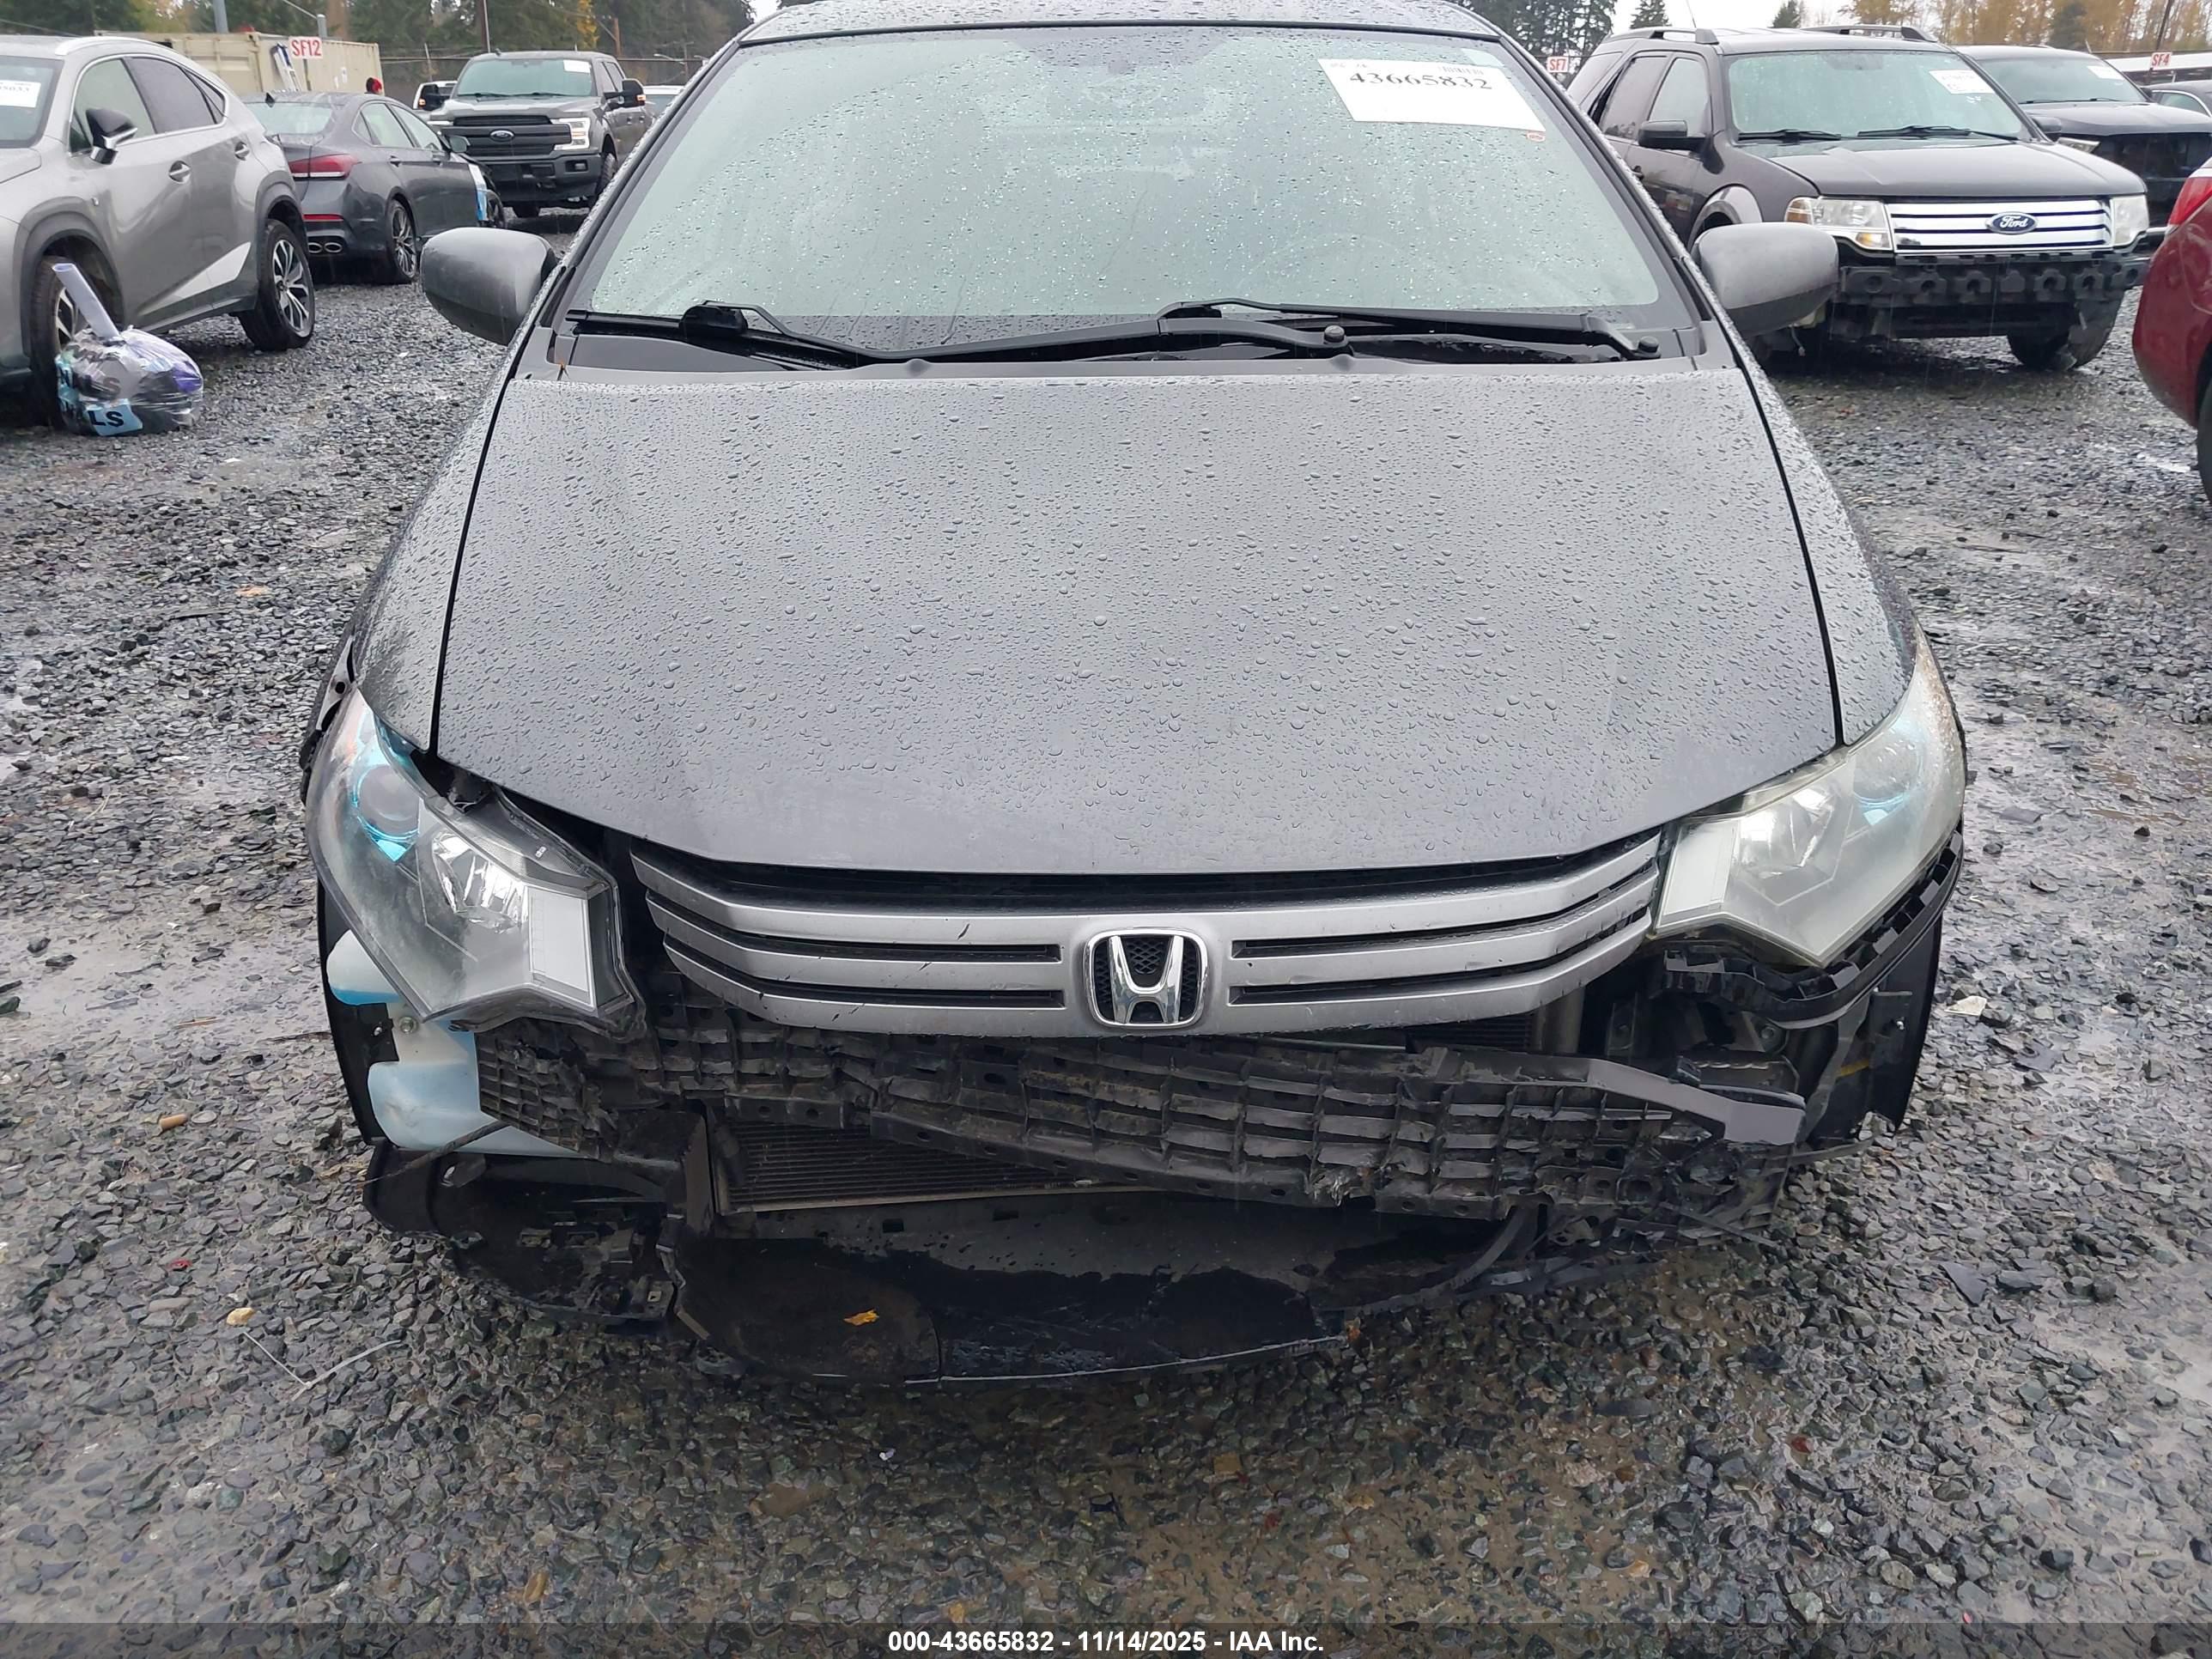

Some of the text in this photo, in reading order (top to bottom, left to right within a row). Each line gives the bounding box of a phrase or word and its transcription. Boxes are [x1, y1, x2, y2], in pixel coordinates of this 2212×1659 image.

[291, 39, 322, 57] SF12
[1549, 58, 1567, 71] SF7
[2151, 52, 2171, 67] SF4
[1349, 71, 1493, 90] 43665832
[1999, 215, 2029, 228] Ford
